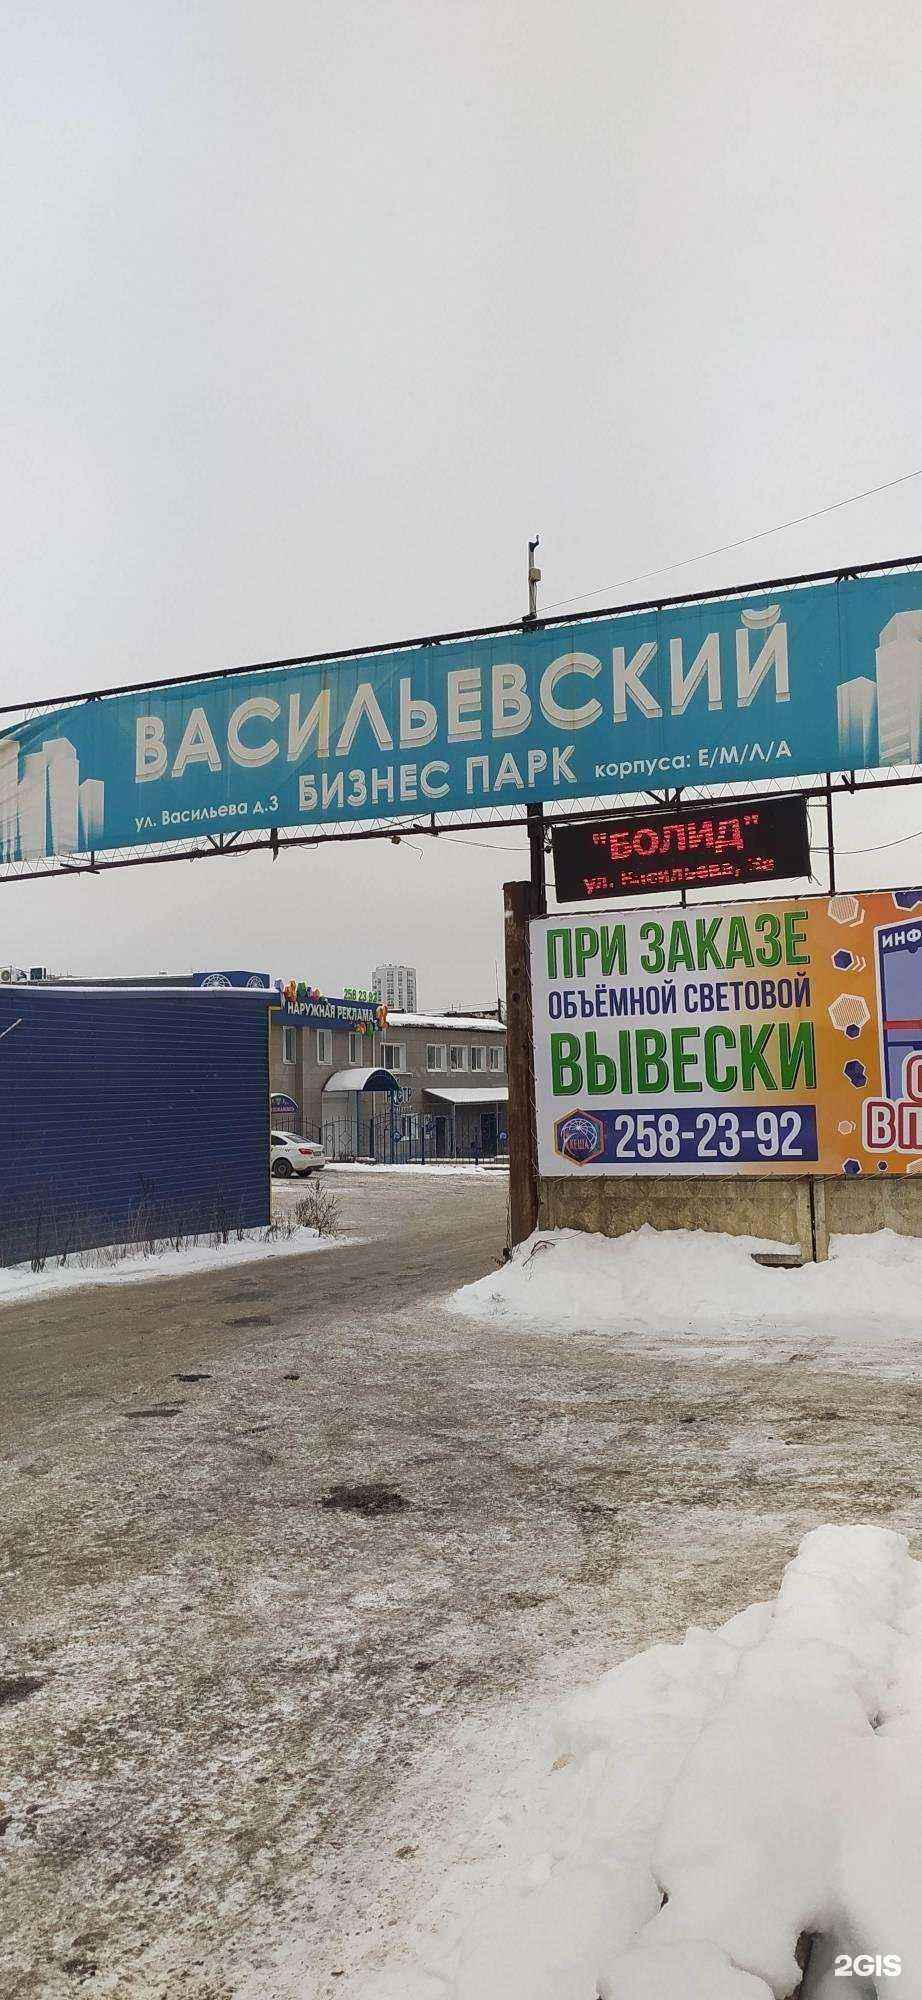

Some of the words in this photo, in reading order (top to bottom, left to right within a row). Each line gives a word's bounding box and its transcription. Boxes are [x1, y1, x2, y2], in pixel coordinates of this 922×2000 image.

[135, 604, 791, 784] ВАСИЛЬЕВСКИЙ
[299, 760, 451, 811] БИЗНЕС
[466, 745, 578, 794] ПАРК
[594, 754, 691, 779] корпуса:
[698, 740, 792, 769] Е/М/Л/А
[134, 815, 157, 832] ул.
[161, 801, 248, 825] Васильева
[252, 795, 280, 814] д.3
[592, 811, 760, 860] "БОЛИД"
[545, 924, 628, 980] ПРИ
[639, 911, 811, 974] ЗАКАЗЕ
[288, 1001, 335, 1019] НАРУЖНАЯ
[337, 1005, 374, 1022] РЕКЛАМА
[548, 979, 678, 1020] ОБЪЁМНОЙ
[684, 971, 812, 1014] СВЕТОВОЙ
[550, 1021, 817, 1097] ВЫВЕСКИ
[614, 1111, 803, 1158] 258-23-92
